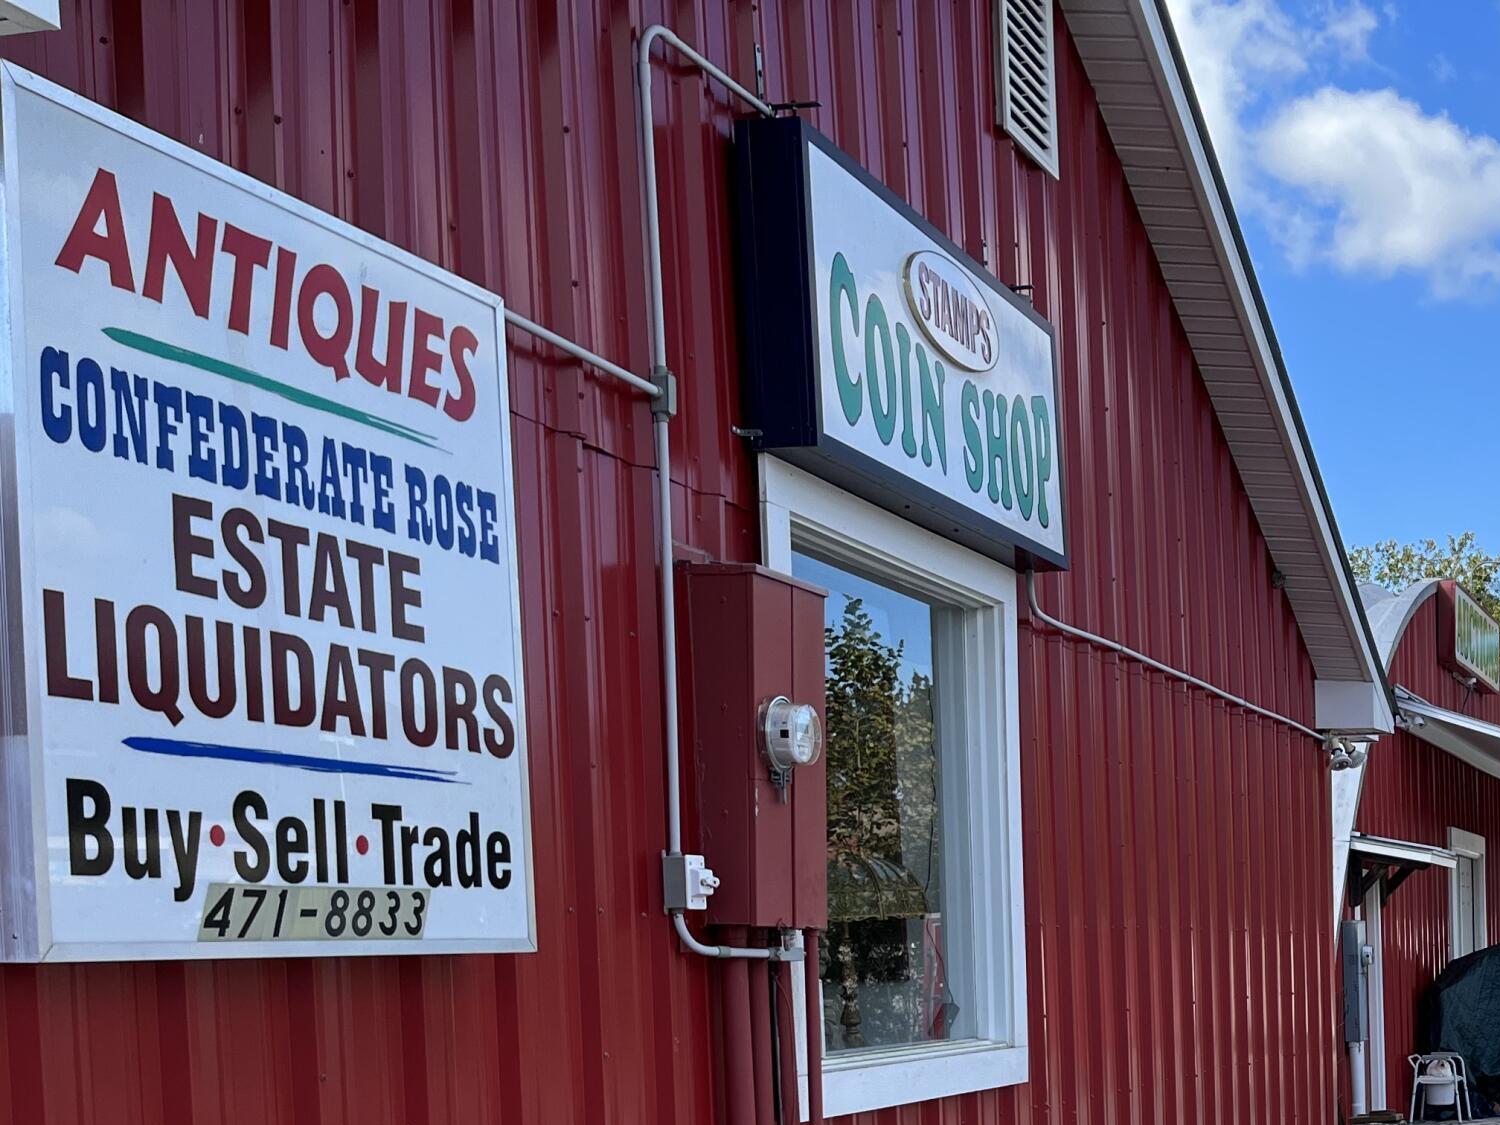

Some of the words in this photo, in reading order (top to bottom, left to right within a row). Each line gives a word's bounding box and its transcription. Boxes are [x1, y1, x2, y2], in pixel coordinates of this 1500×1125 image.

[54, 167, 479, 423] ANTIQUES
[918, 261, 992, 365] STAMPS
[40, 345, 396, 535] CONFEDERATE
[404, 463, 500, 565] ROSE
[830, 251, 947, 476] COIN
[961, 379, 1052, 529] SHOP
[171, 493, 425, 644] ESTATE
[42, 589, 515, 759] LIQUIDATORS
[66, 778, 203, 902] Buy
[232, 790, 350, 884] Sell
[371, 803, 512, 890] Trade
[203, 889, 426, 938] 471-8833
